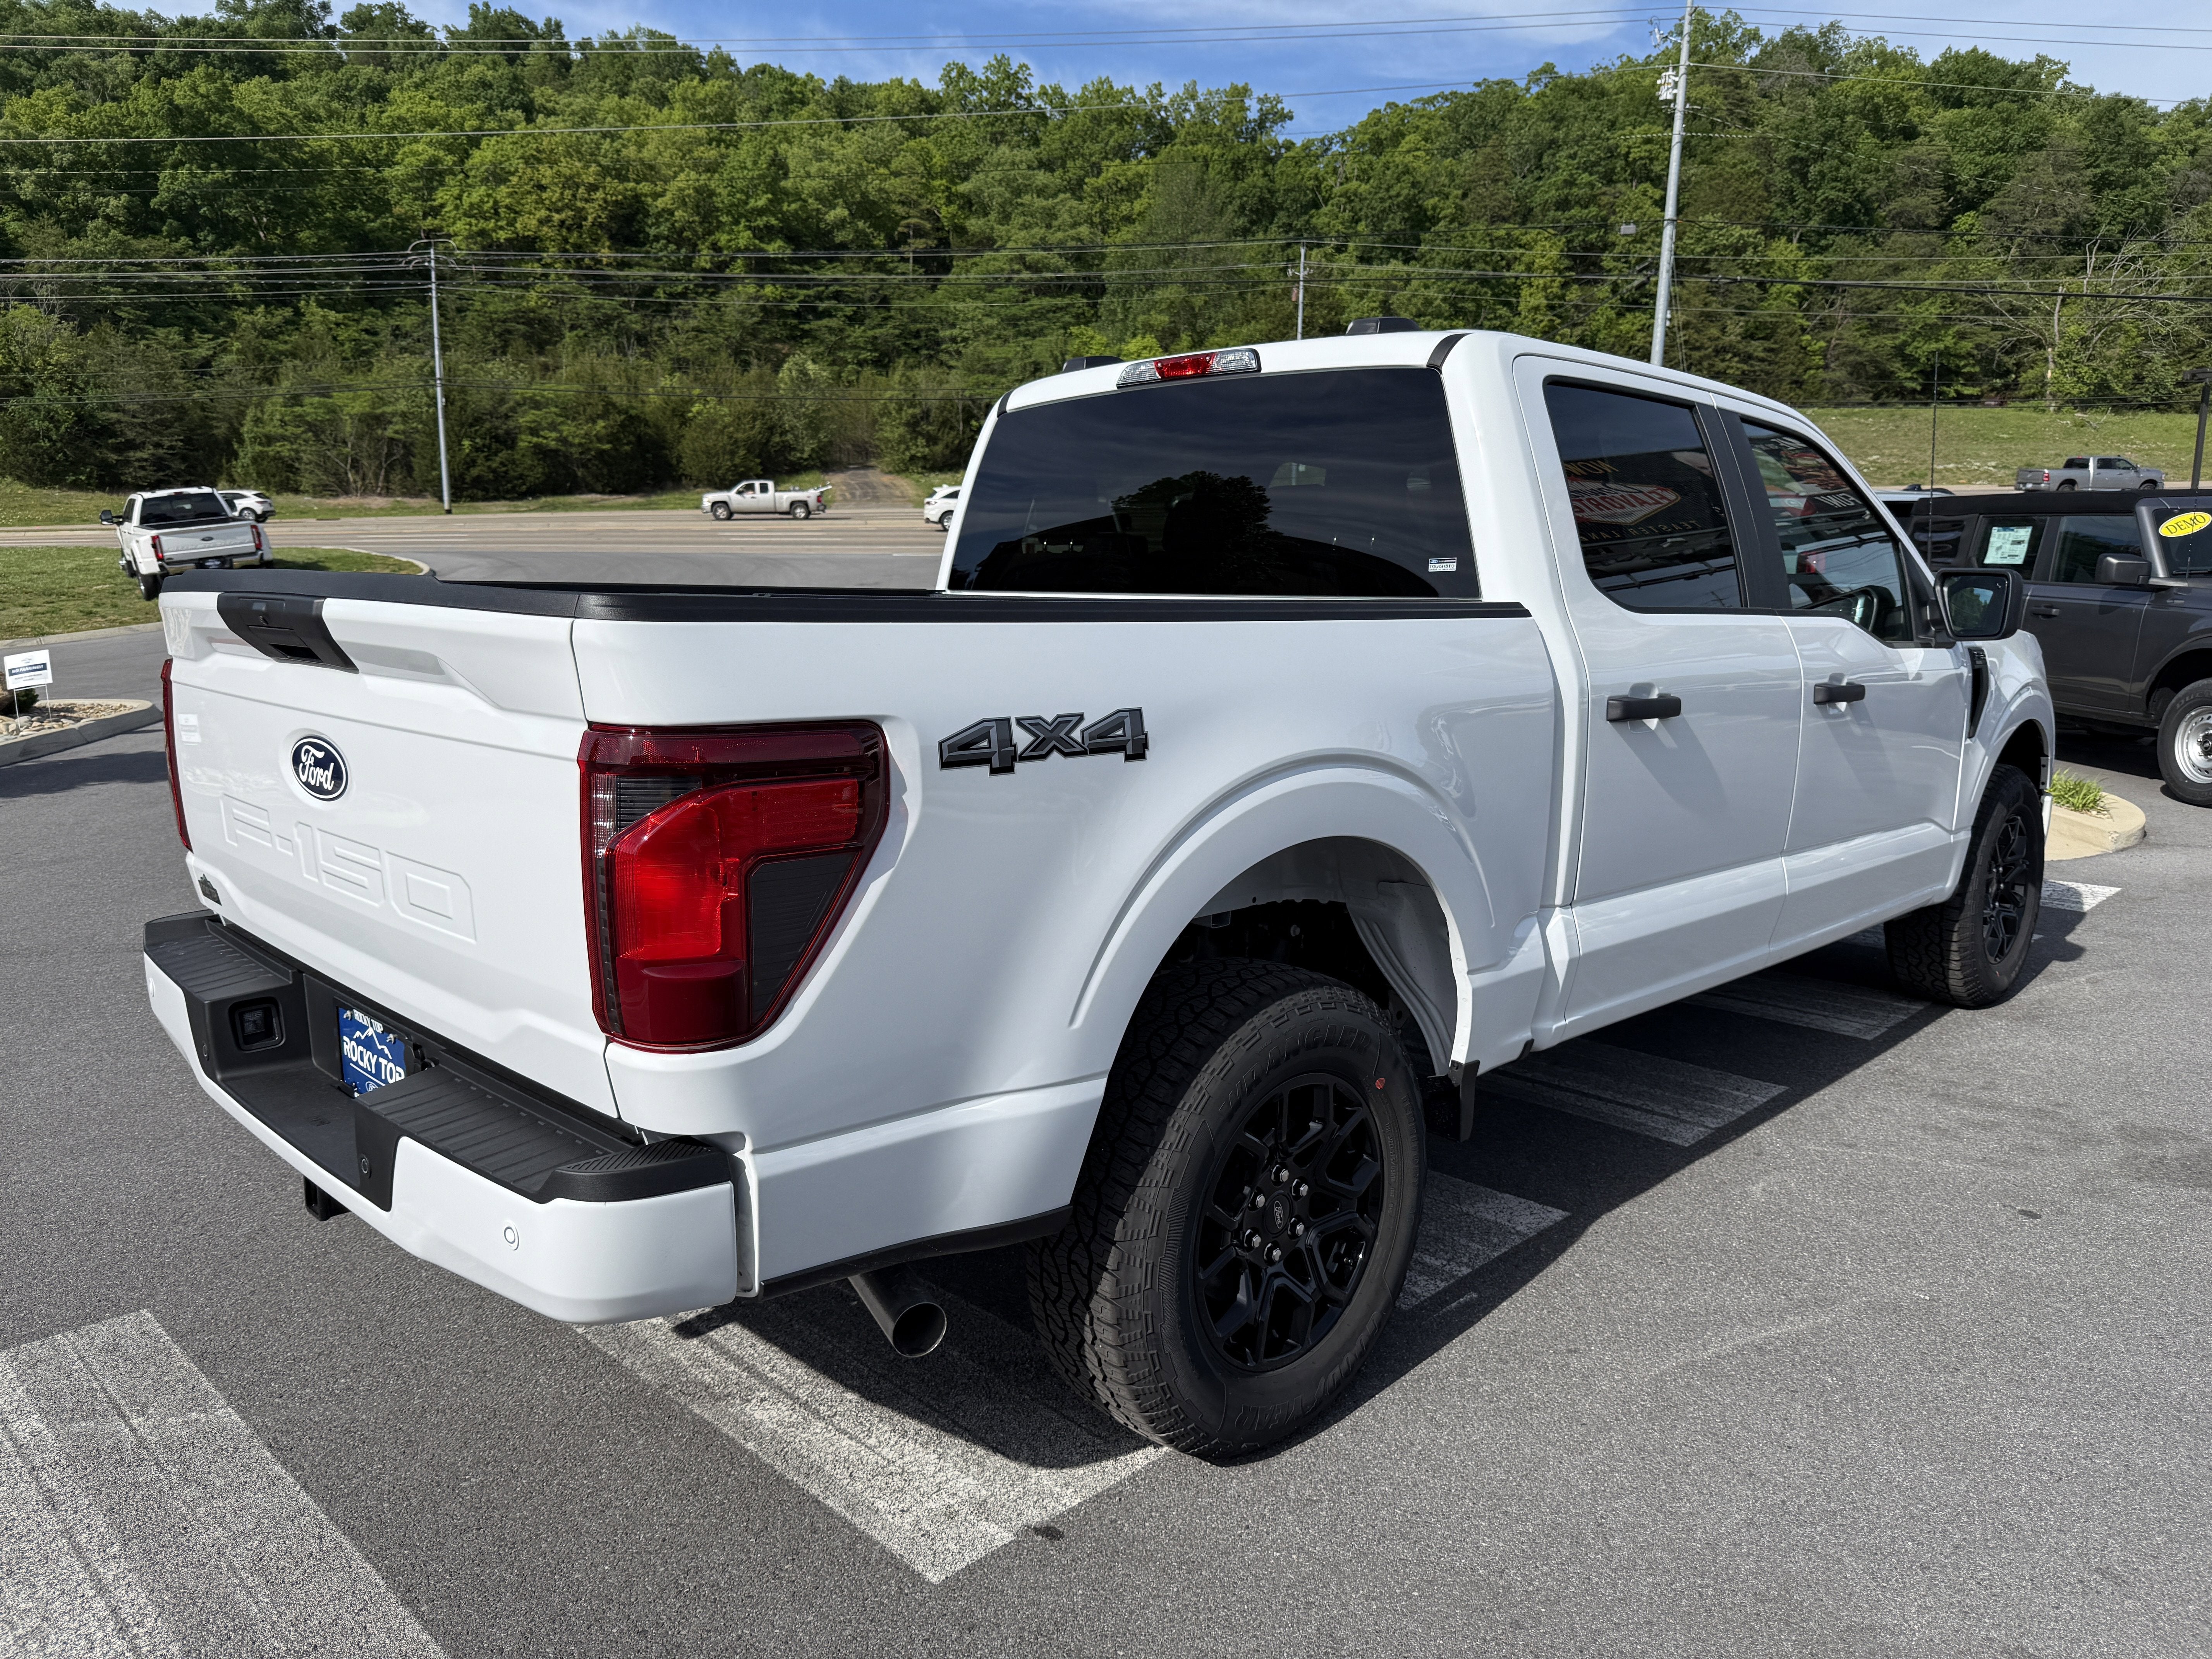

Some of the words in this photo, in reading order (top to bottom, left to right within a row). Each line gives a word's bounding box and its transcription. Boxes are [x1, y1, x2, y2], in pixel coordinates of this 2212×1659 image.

[2166, 515, 2206, 534] DEMO
[299, 745, 335, 791] Ford
[220, 793, 477, 945] F-150
[343, 1036, 377, 1074] ROCKY
[379, 1057, 405, 1084] TOP
